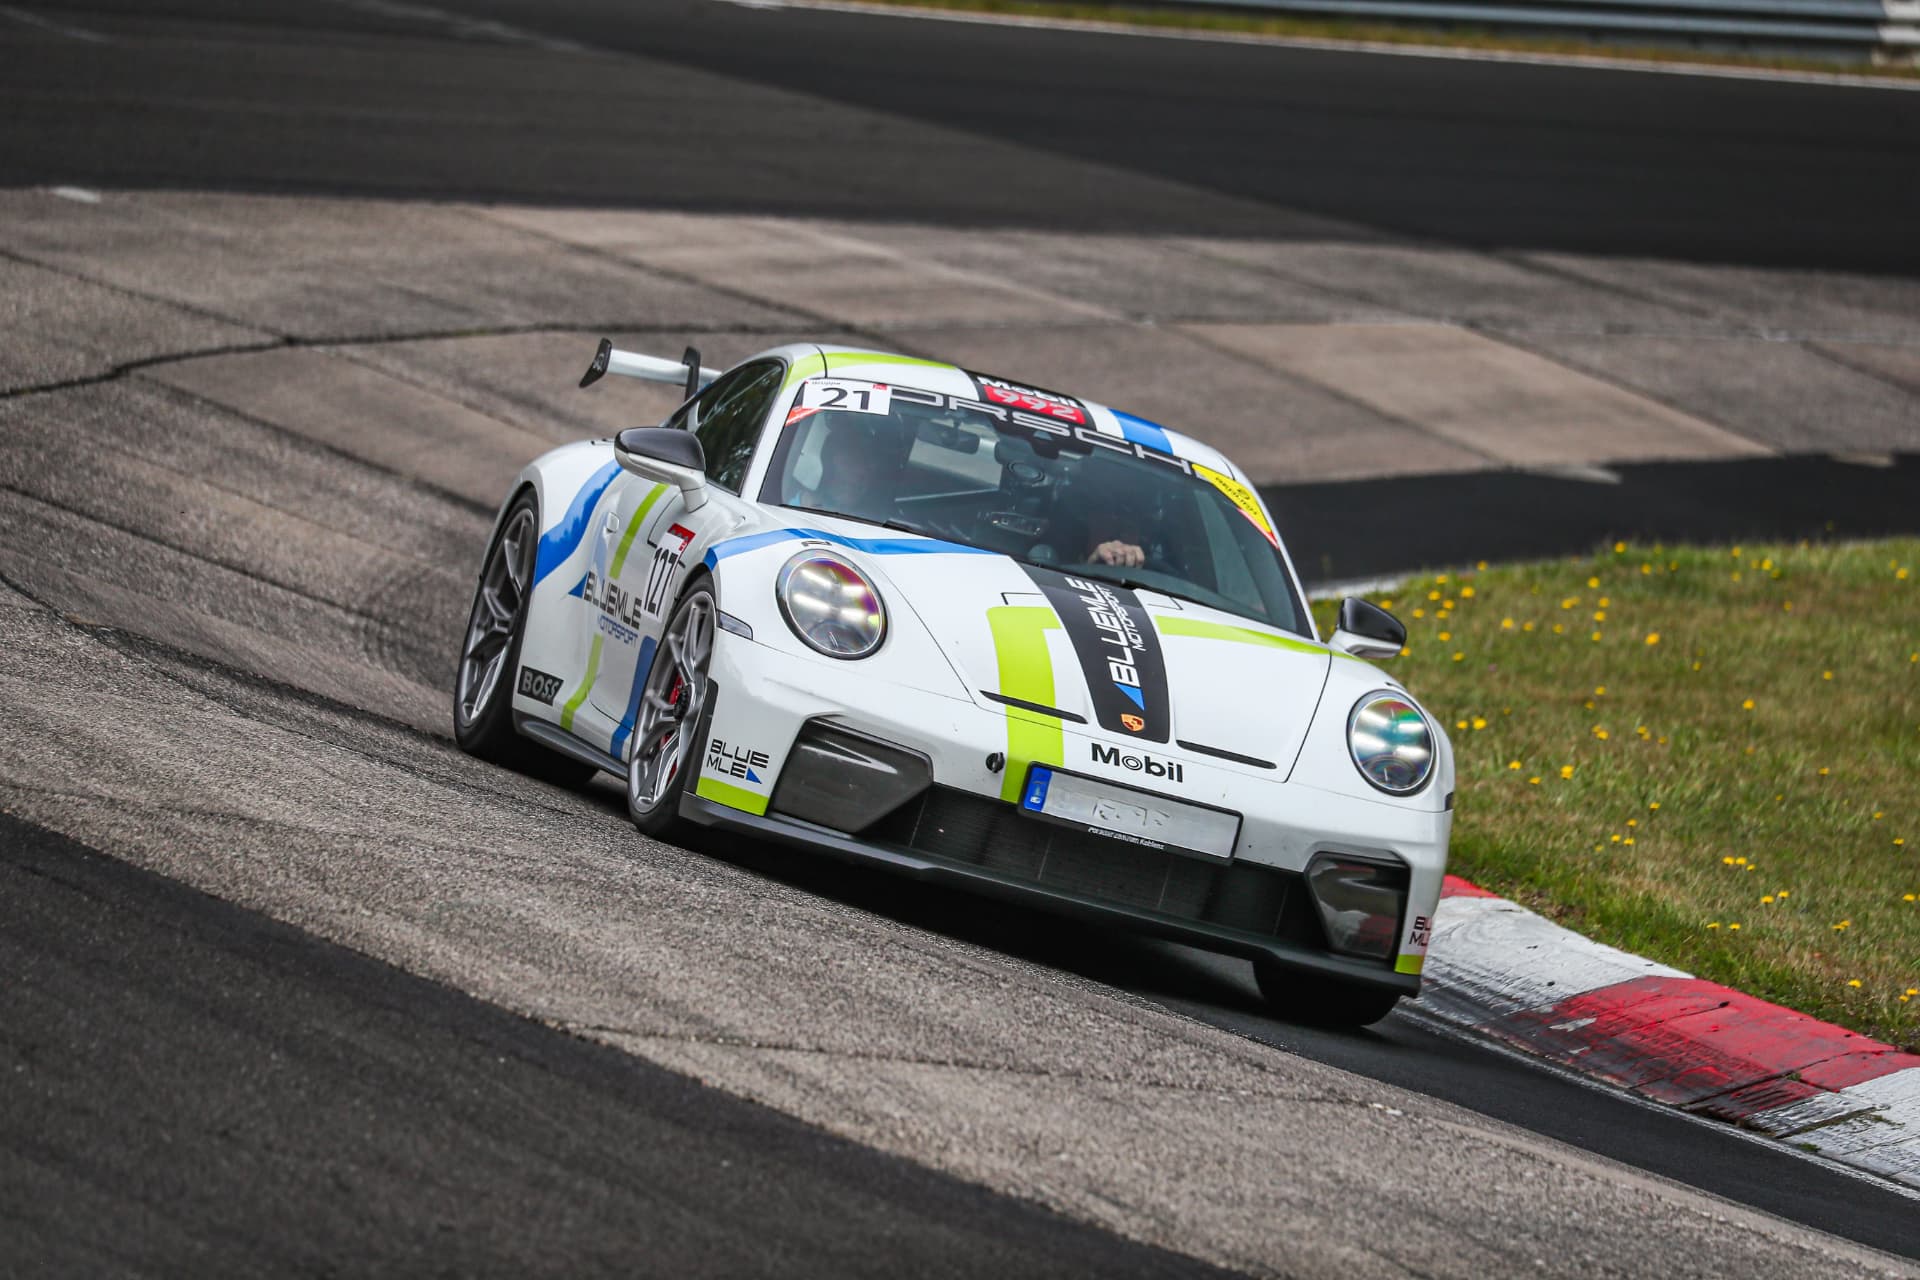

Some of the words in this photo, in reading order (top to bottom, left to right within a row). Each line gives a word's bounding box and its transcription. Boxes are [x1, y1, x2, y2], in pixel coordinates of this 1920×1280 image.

[819, 387, 870, 410] 21
[977, 376, 1080, 408] Mobil
[993, 387, 1078, 421] 992
[888, 387, 1208, 480] ORSCH
[583, 571, 642, 630] BLUEMLE
[644, 547, 679, 618] 127
[1064, 576, 1141, 687] BLUEMLE
[1095, 584, 1146, 651] MOTORSPORT
[521, 671, 559, 700] BOSS
[706, 754, 746, 779] MLE
[710, 739, 769, 768] BLUE
[1091, 743, 1183, 783] Mobil
